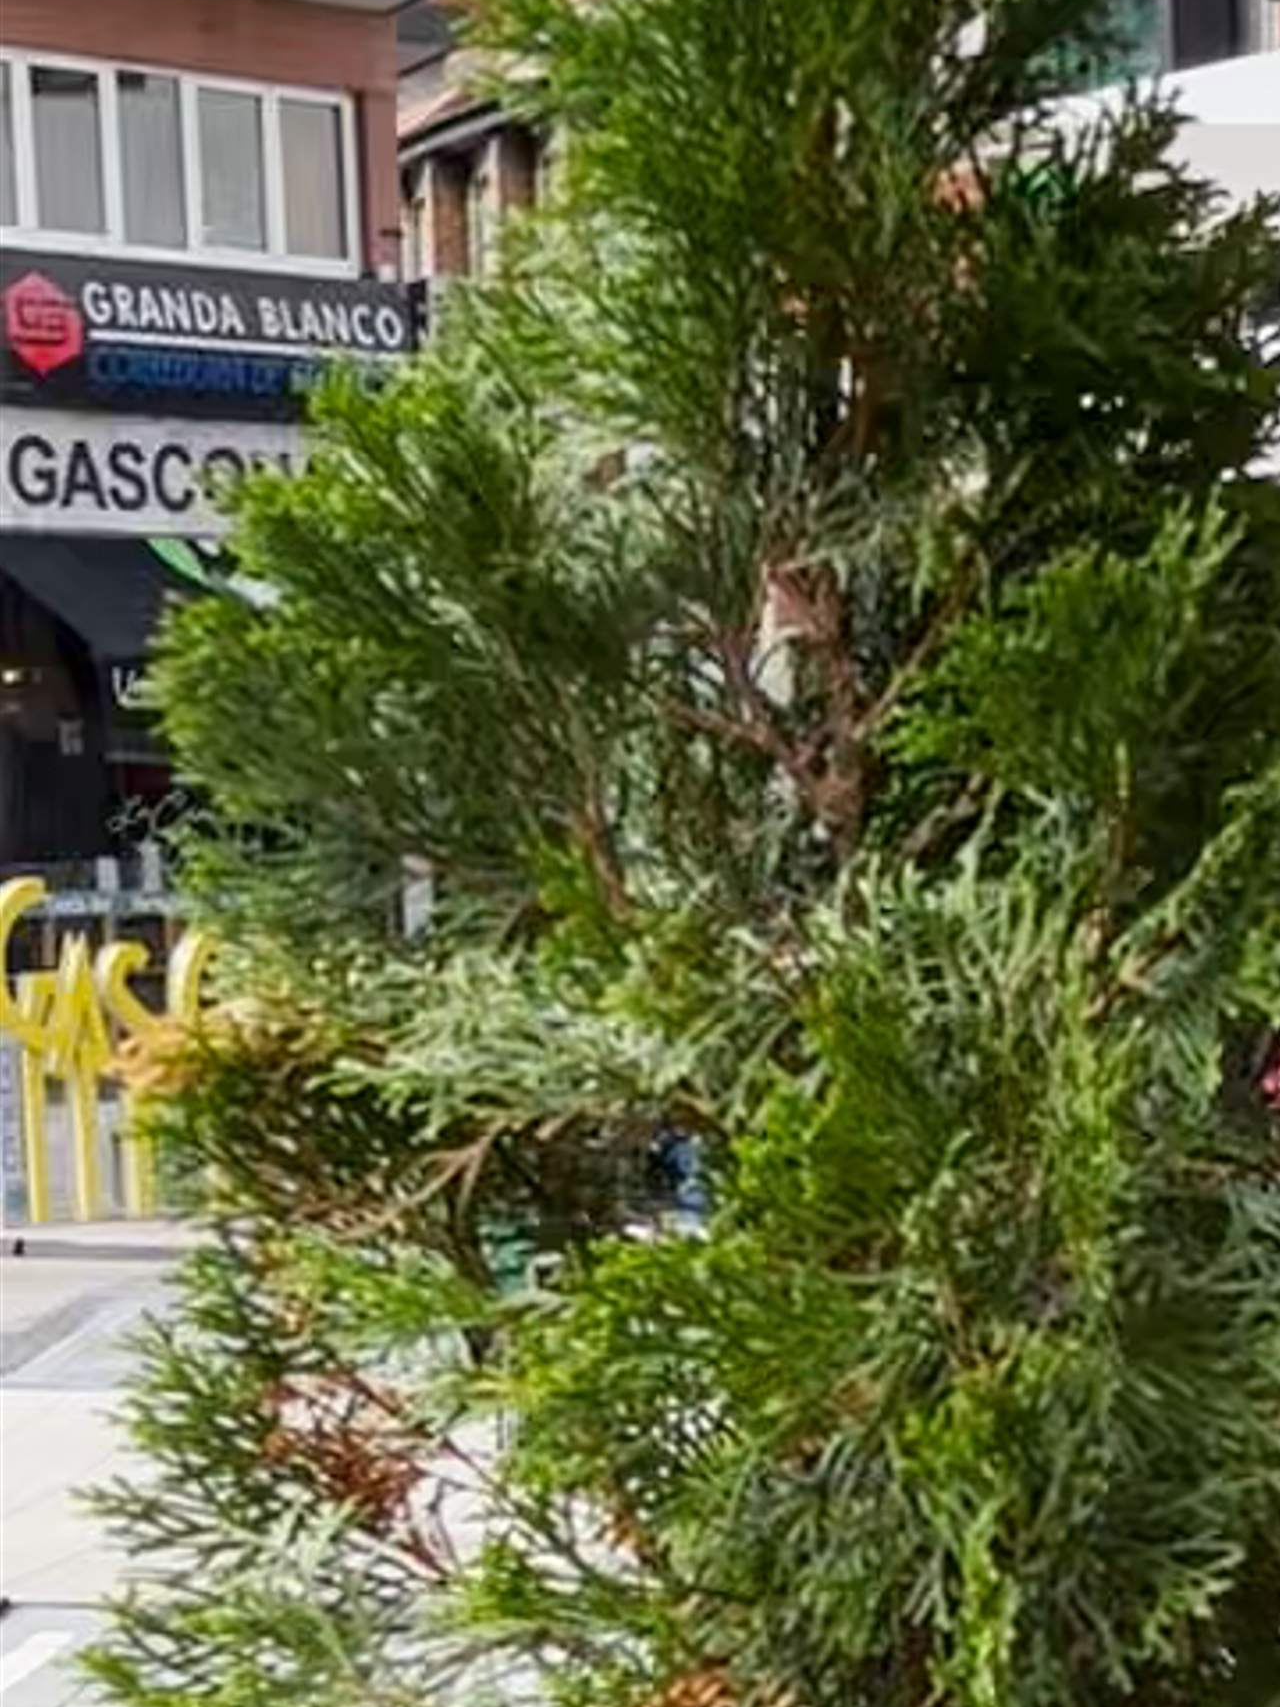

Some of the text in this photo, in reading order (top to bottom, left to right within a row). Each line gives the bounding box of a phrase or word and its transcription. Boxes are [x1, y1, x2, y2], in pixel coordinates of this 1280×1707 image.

[83, 282, 245, 335] GRANDA
[260, 298, 402, 346] BLANCO
[8, 434, 316, 512] GASCO
